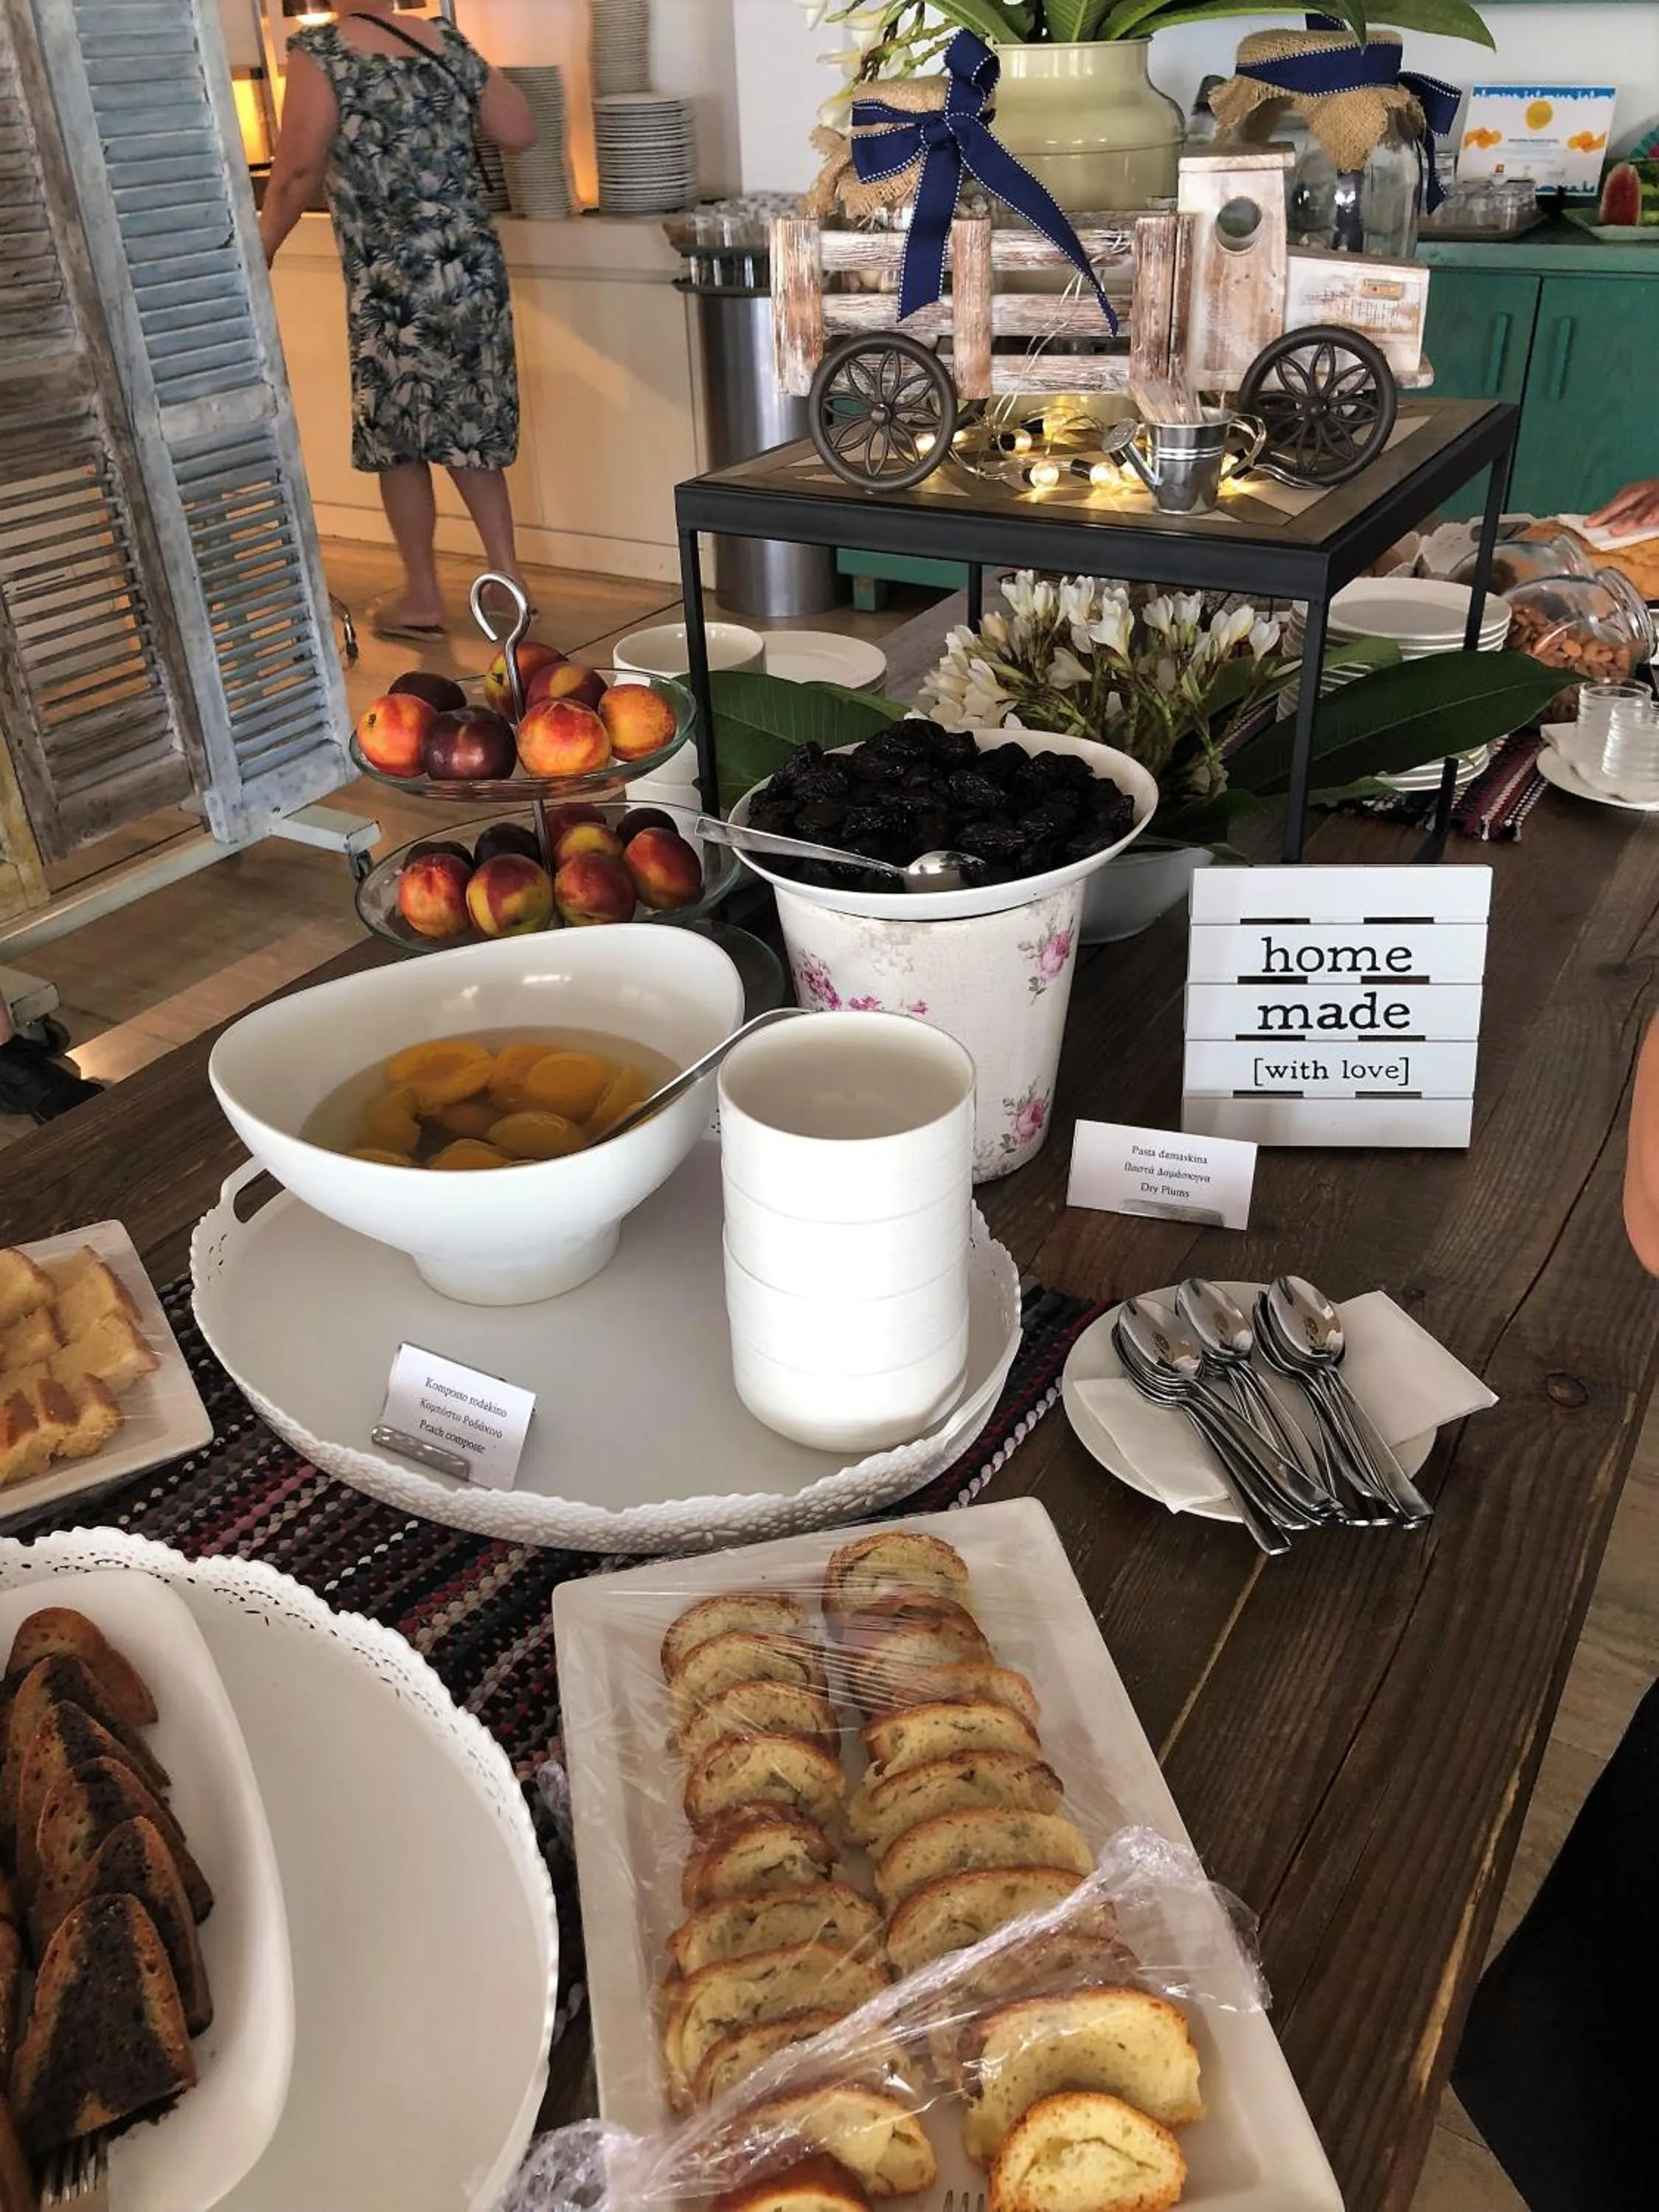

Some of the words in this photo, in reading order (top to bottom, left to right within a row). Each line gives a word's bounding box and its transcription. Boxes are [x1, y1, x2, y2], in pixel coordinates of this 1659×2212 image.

[1262, 936, 1412, 973] home
[1257, 992, 1411, 1030] made
[1132, 1145, 1155, 1157] Pasta
[1140, 1182, 1159, 1194] Dry
[1161, 1185, 1189, 1198] Plums
[419, 1419, 445, 1438] Peach
